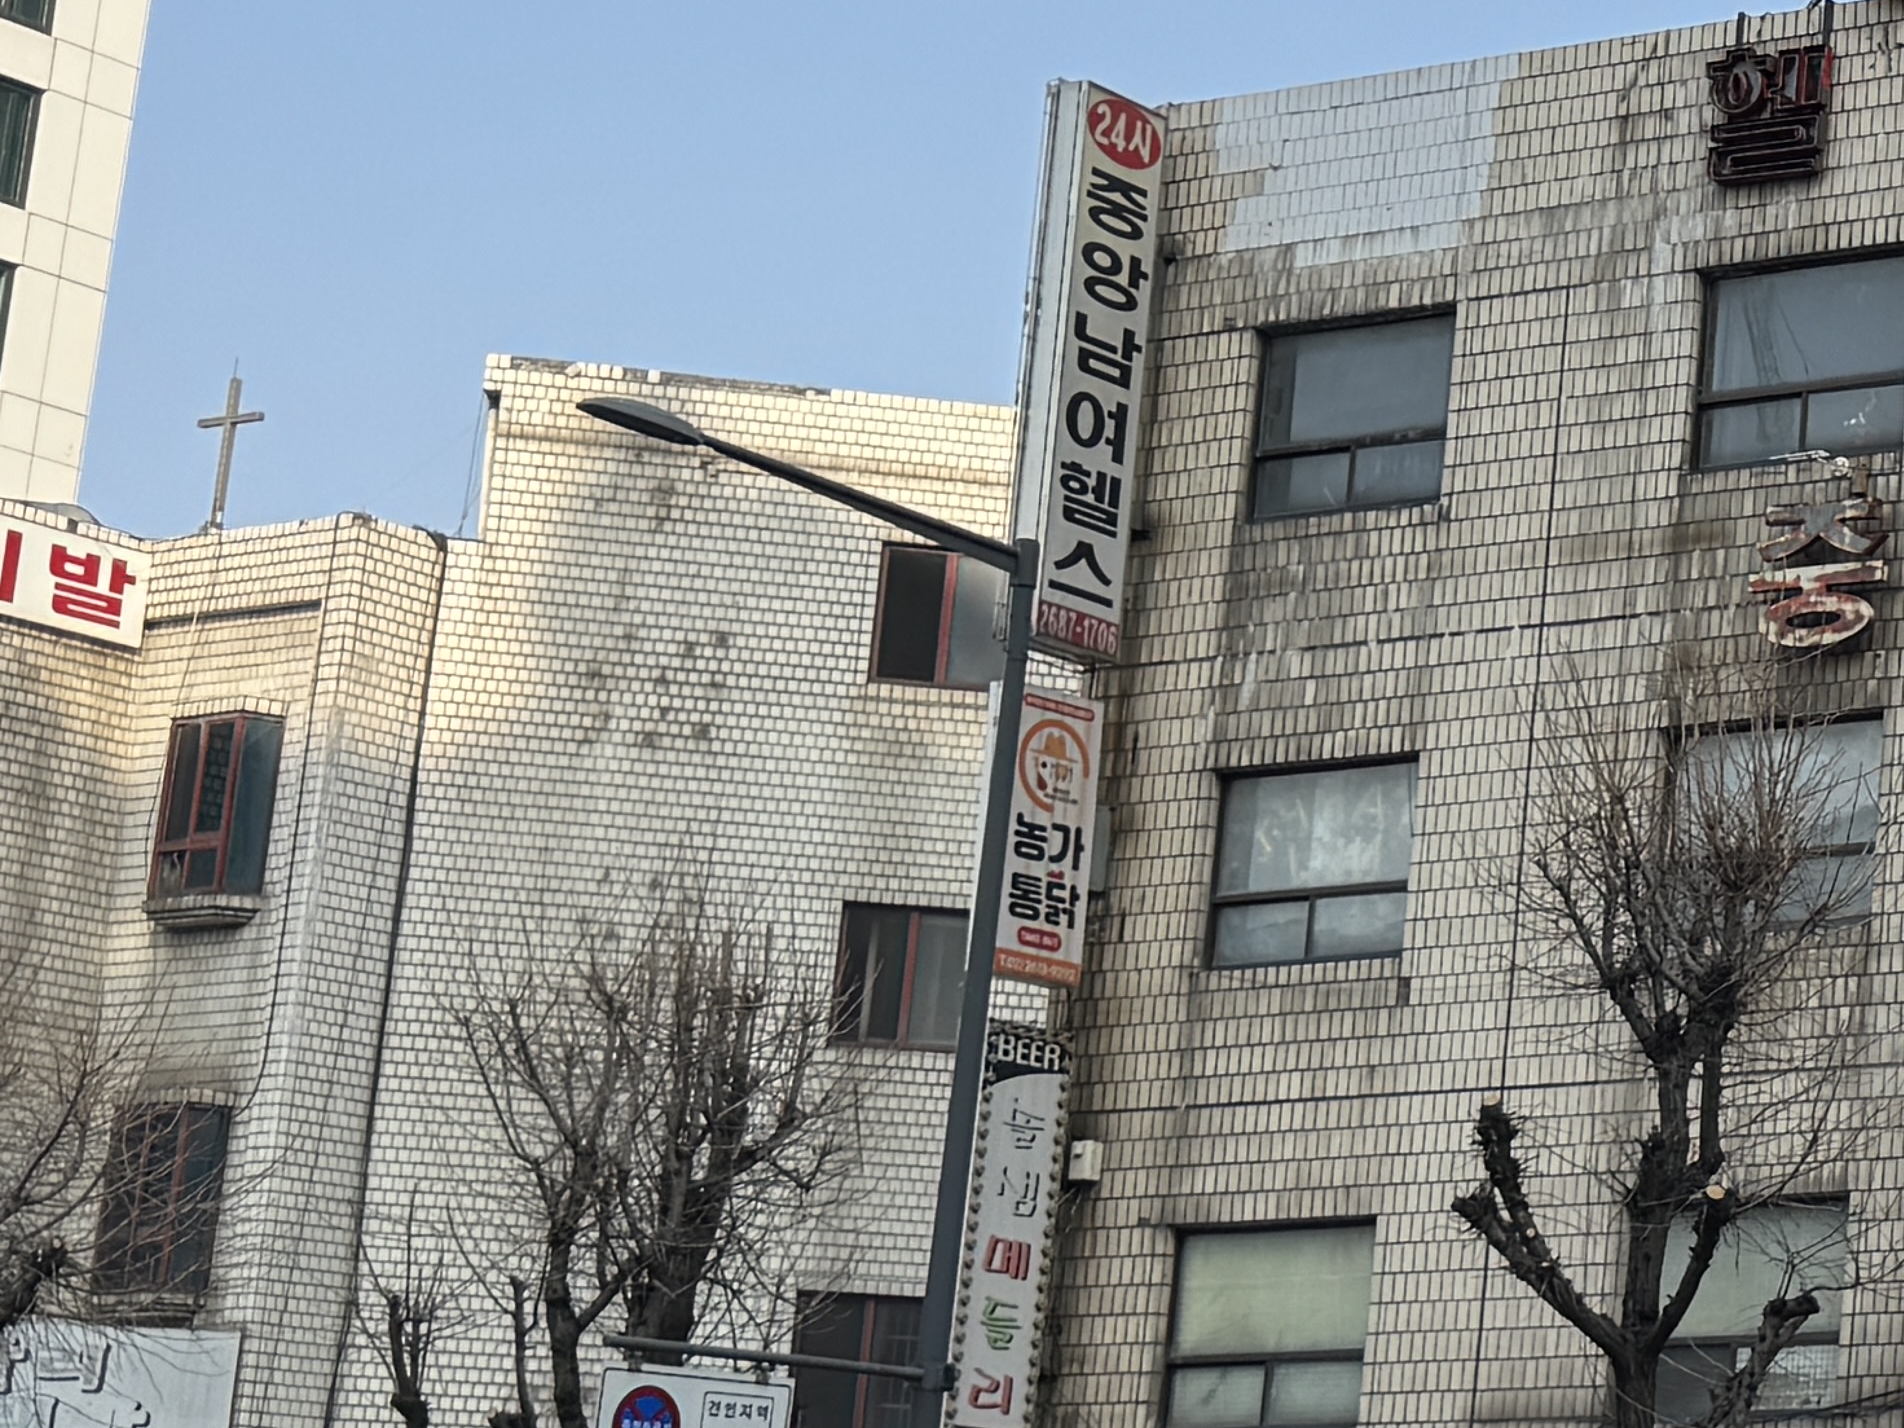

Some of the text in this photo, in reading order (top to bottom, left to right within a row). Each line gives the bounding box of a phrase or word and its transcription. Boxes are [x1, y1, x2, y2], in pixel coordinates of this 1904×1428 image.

[1091, 100, 1160, 165] 24시
[1047, 166, 1151, 611] 중앙남여헬스
[1039, 598, 1119, 656] 2687-1706
[1014, 811, 1086, 872] 농가
[1008, 870, 1081, 930] 통닭
[999, 1035, 1062, 1072] BEER
[708, 1399, 770, 1421] 견인지역
